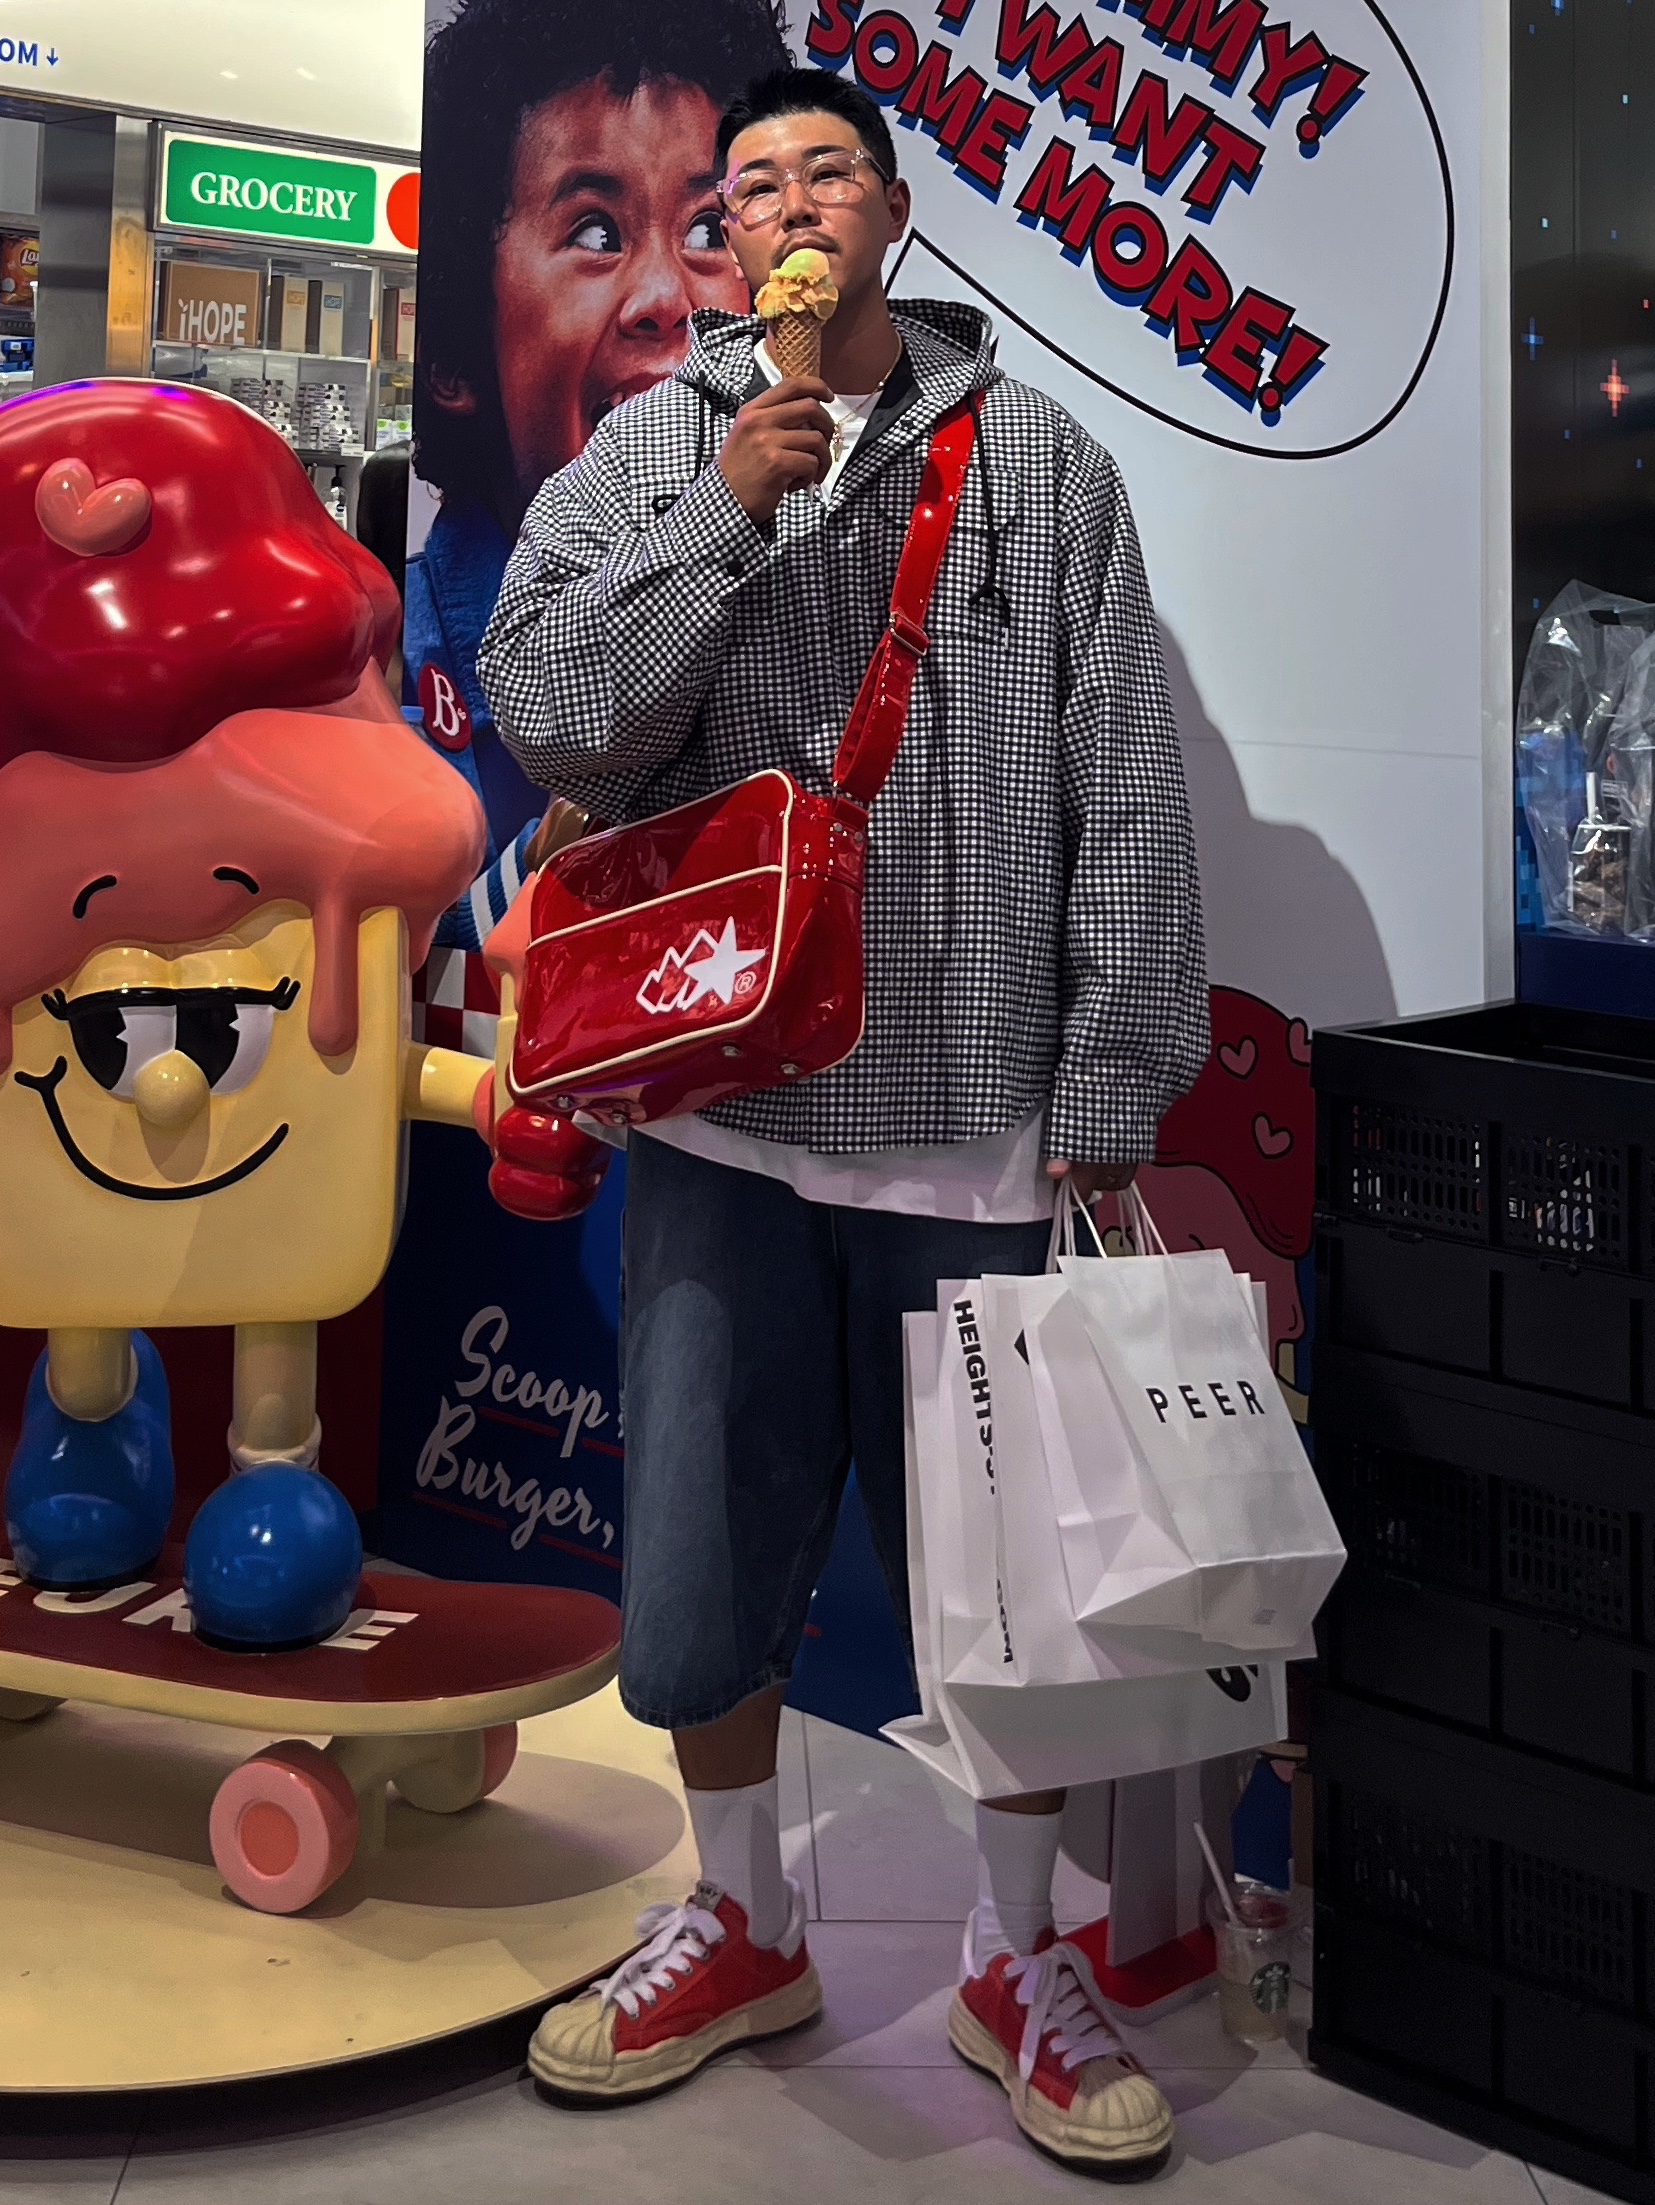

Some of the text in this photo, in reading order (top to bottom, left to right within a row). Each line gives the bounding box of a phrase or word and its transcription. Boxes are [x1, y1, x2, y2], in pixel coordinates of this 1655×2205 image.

[994, 0, 1267, 225] WANT
[190, 171, 358, 222] GROCERY
[805, 0, 1331, 428] SOME MORE!
[178, 298, 247, 345] iHOPE
[1145, 1380, 1266, 1424] PEER
[416, 1396, 616, 1551] Burger,
